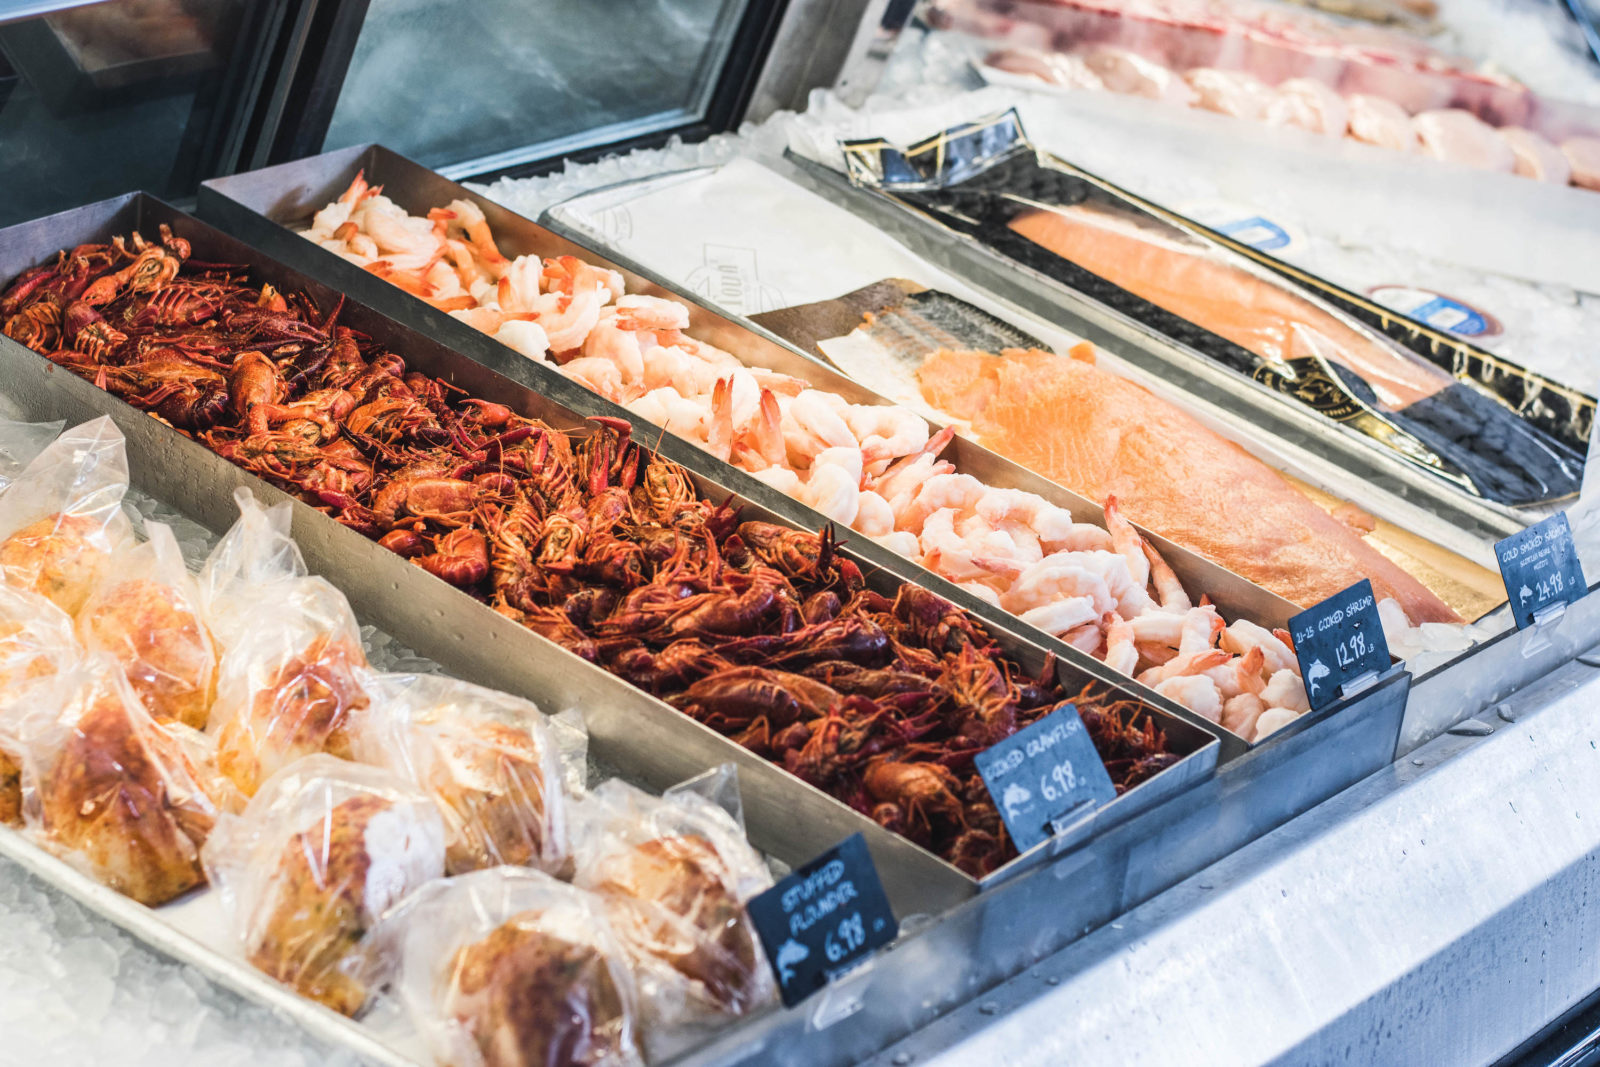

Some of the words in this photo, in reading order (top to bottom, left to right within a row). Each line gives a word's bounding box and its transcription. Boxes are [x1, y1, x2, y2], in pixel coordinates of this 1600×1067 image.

[1502, 547, 1519, 563] COLD
[1520, 535, 1543, 555] SMOKED
[1535, 570, 1564, 602] 24.98
[1568, 576, 1576, 586] LB
[1296, 625, 1315, 644] 21-25
[1318, 609, 1344, 632] COOKED
[1345, 595, 1373, 618] SHRIMP
[1368, 643, 1375, 653] LB
[985, 749, 1024, 782] COOKED
[1026, 718, 1082, 758] CRAWFISH
[1041, 759, 1077, 801] 6.98
[781, 859, 845, 913] STUFFED
[789, 880, 859, 937] FLOUNDER
[825, 911, 866, 963] 6.98
